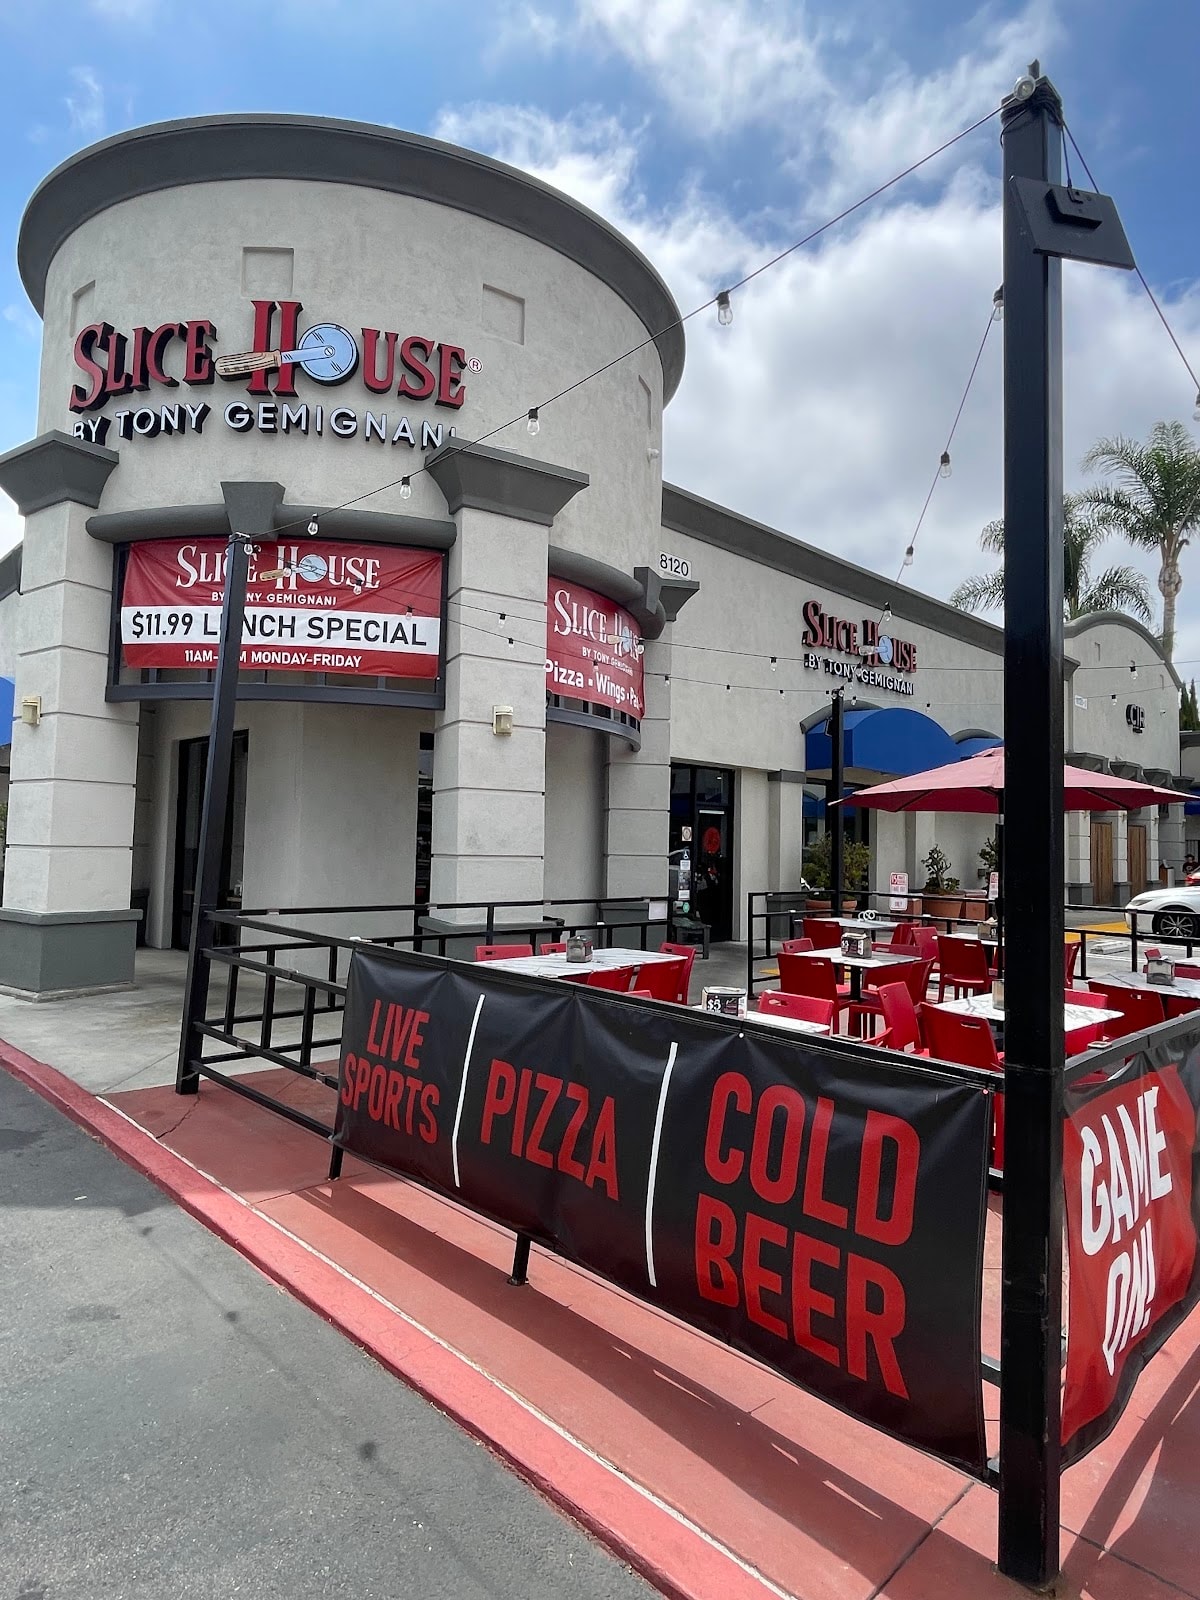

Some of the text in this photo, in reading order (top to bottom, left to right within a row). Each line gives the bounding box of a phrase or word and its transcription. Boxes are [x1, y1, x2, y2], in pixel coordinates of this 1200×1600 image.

[69, 319, 218, 413] SLICE
[240, 300, 467, 409] HOUSE
[73, 415, 112, 446] BY
[115, 402, 211, 439] TONY
[275, 545, 381, 590] HOUSE
[660, 553, 689, 577] 8120
[266, 594, 337, 606] GEMIGNANI
[554, 589, 608, 644] SLICE
[131, 611, 427, 647] $11.99 LNCH SPECIAL
[582, 646, 591, 658] BY
[802, 600, 918, 673] SLICE HOUSE
[251, 651, 362, 668] MONDAY-FRIDAY
[543, 659, 584, 688] Pizza
[595, 671, 626, 704] Wings
[804, 653, 822, 670] BY
[367, 999, 430, 1070] LIVE
[341, 1052, 440, 1145] SPORTS
[480, 1058, 619, 1201] PIZZA
[704, 1071, 921, 1246] COLD
[1080, 1086, 1173, 1256] GAME
[695, 1192, 910, 1400] BEER
[1102, 1218, 1157, 1377] ON!
